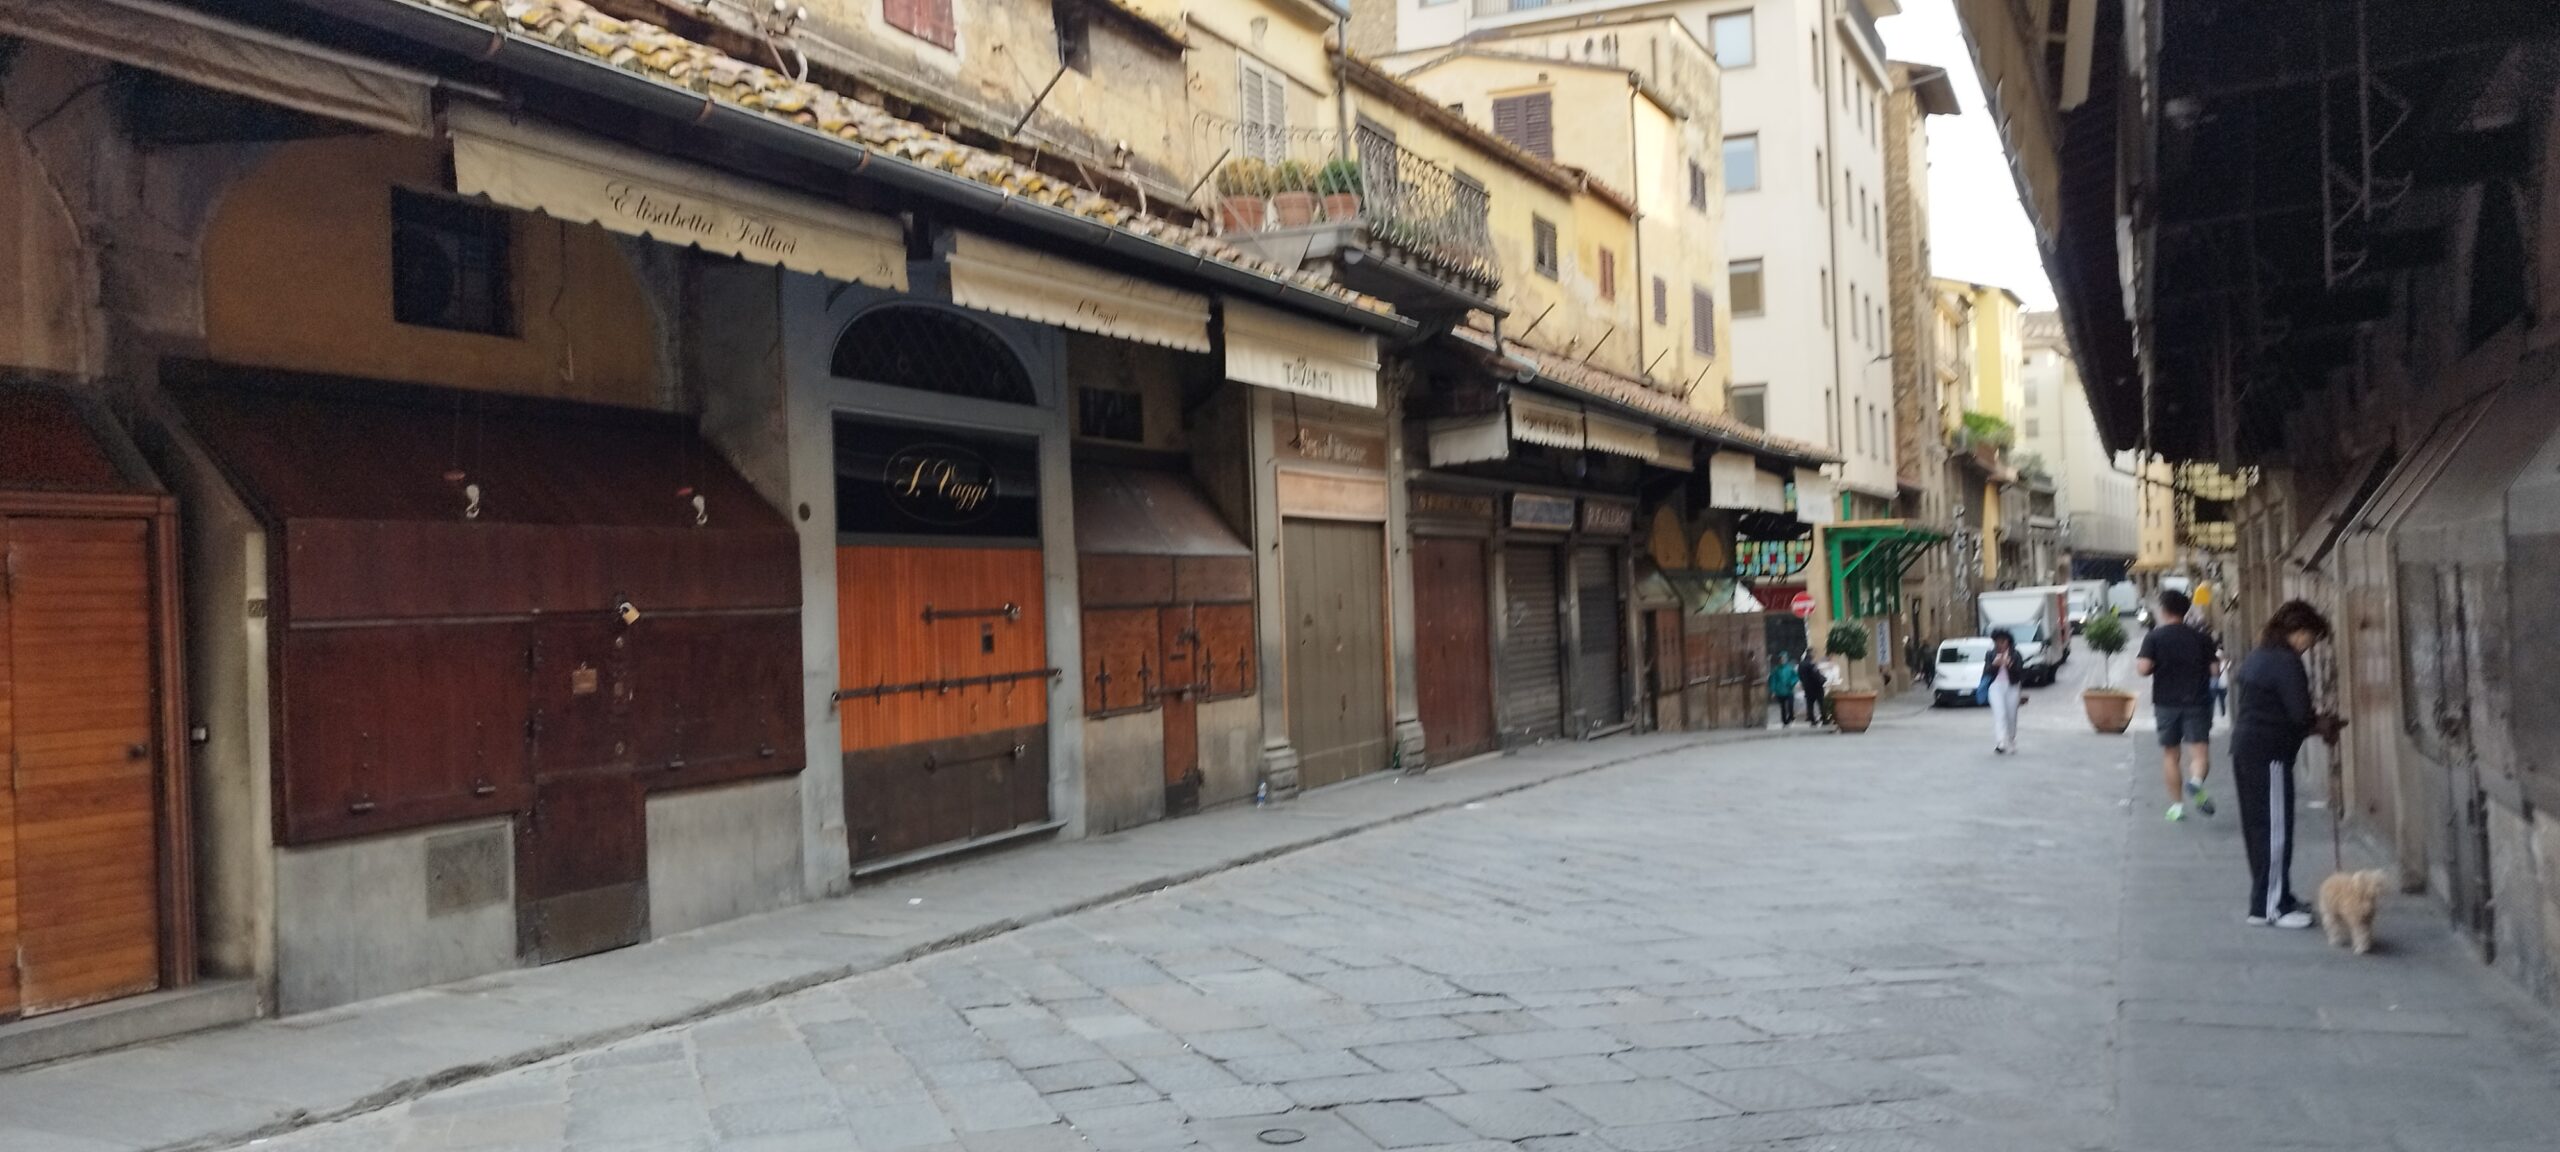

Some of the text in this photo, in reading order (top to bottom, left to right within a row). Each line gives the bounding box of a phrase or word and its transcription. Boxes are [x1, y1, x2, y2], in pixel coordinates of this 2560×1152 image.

[606, 181, 797, 254] Elisabetta Fallaci
[933, 459, 992, 512] Vaggi
